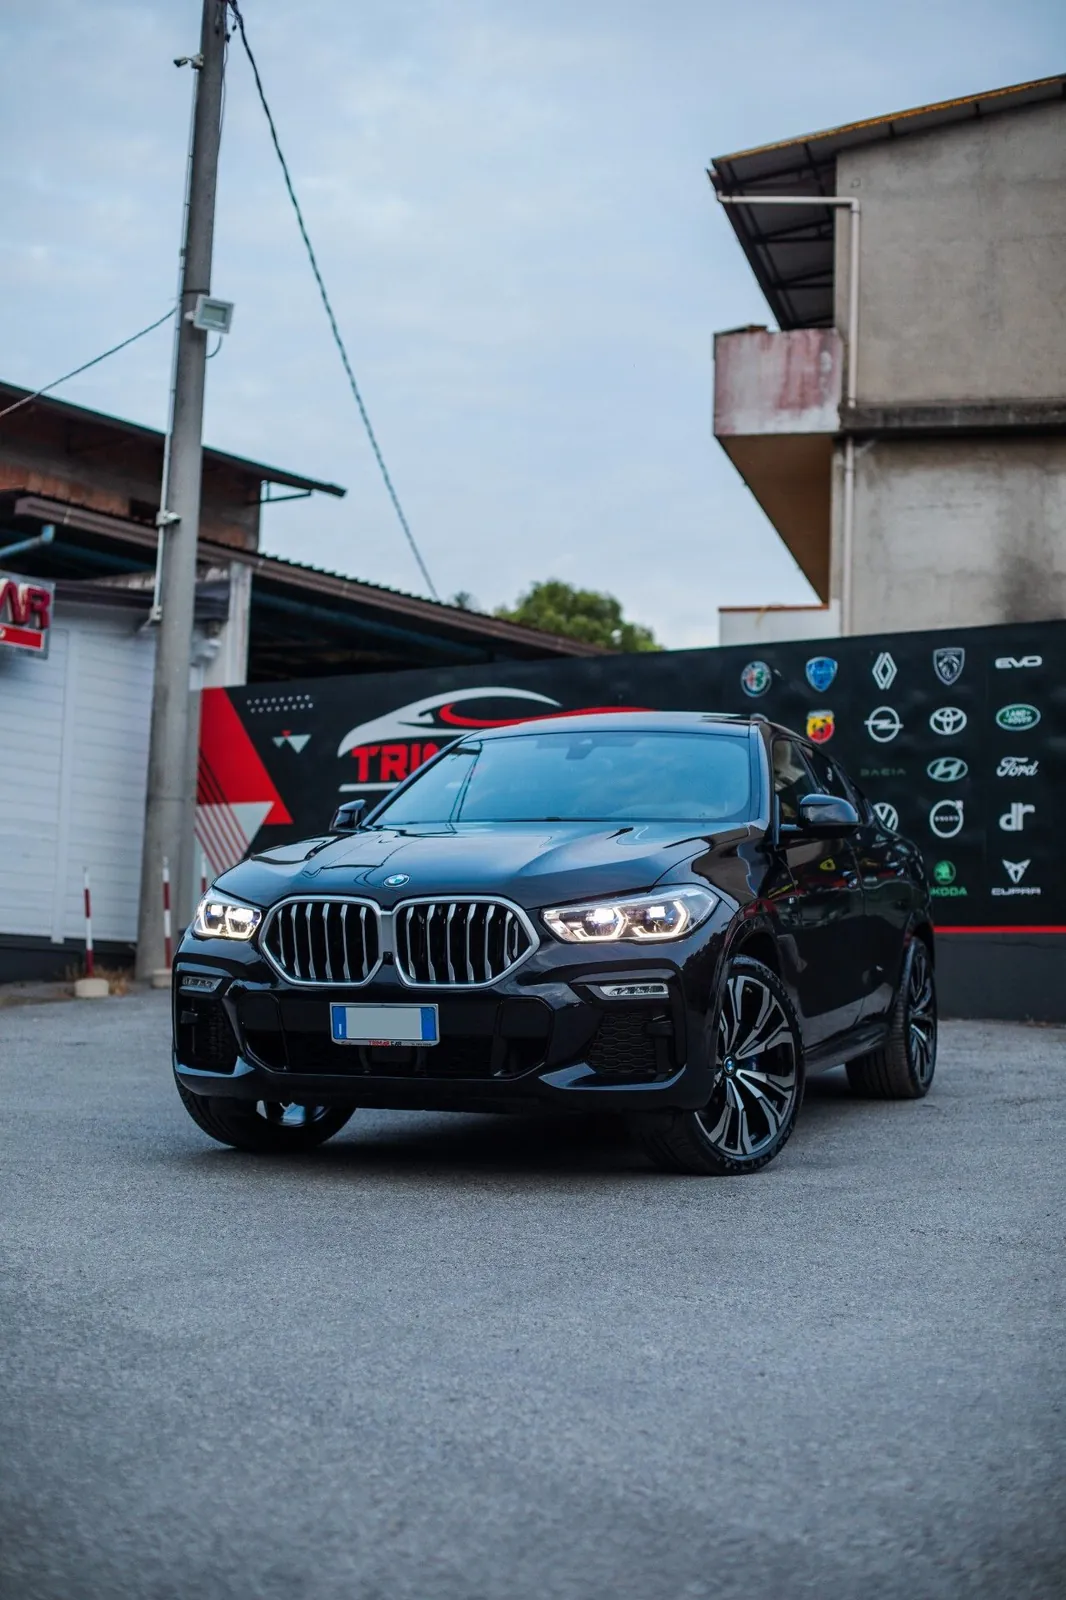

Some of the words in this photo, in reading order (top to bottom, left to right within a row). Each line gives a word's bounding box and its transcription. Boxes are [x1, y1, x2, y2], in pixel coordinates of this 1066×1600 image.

[994, 655, 1043, 669] EVO
[995, 756, 1040, 777] Ford
[999, 801, 1036, 832] dr
[930, 886, 968, 897] KODA
